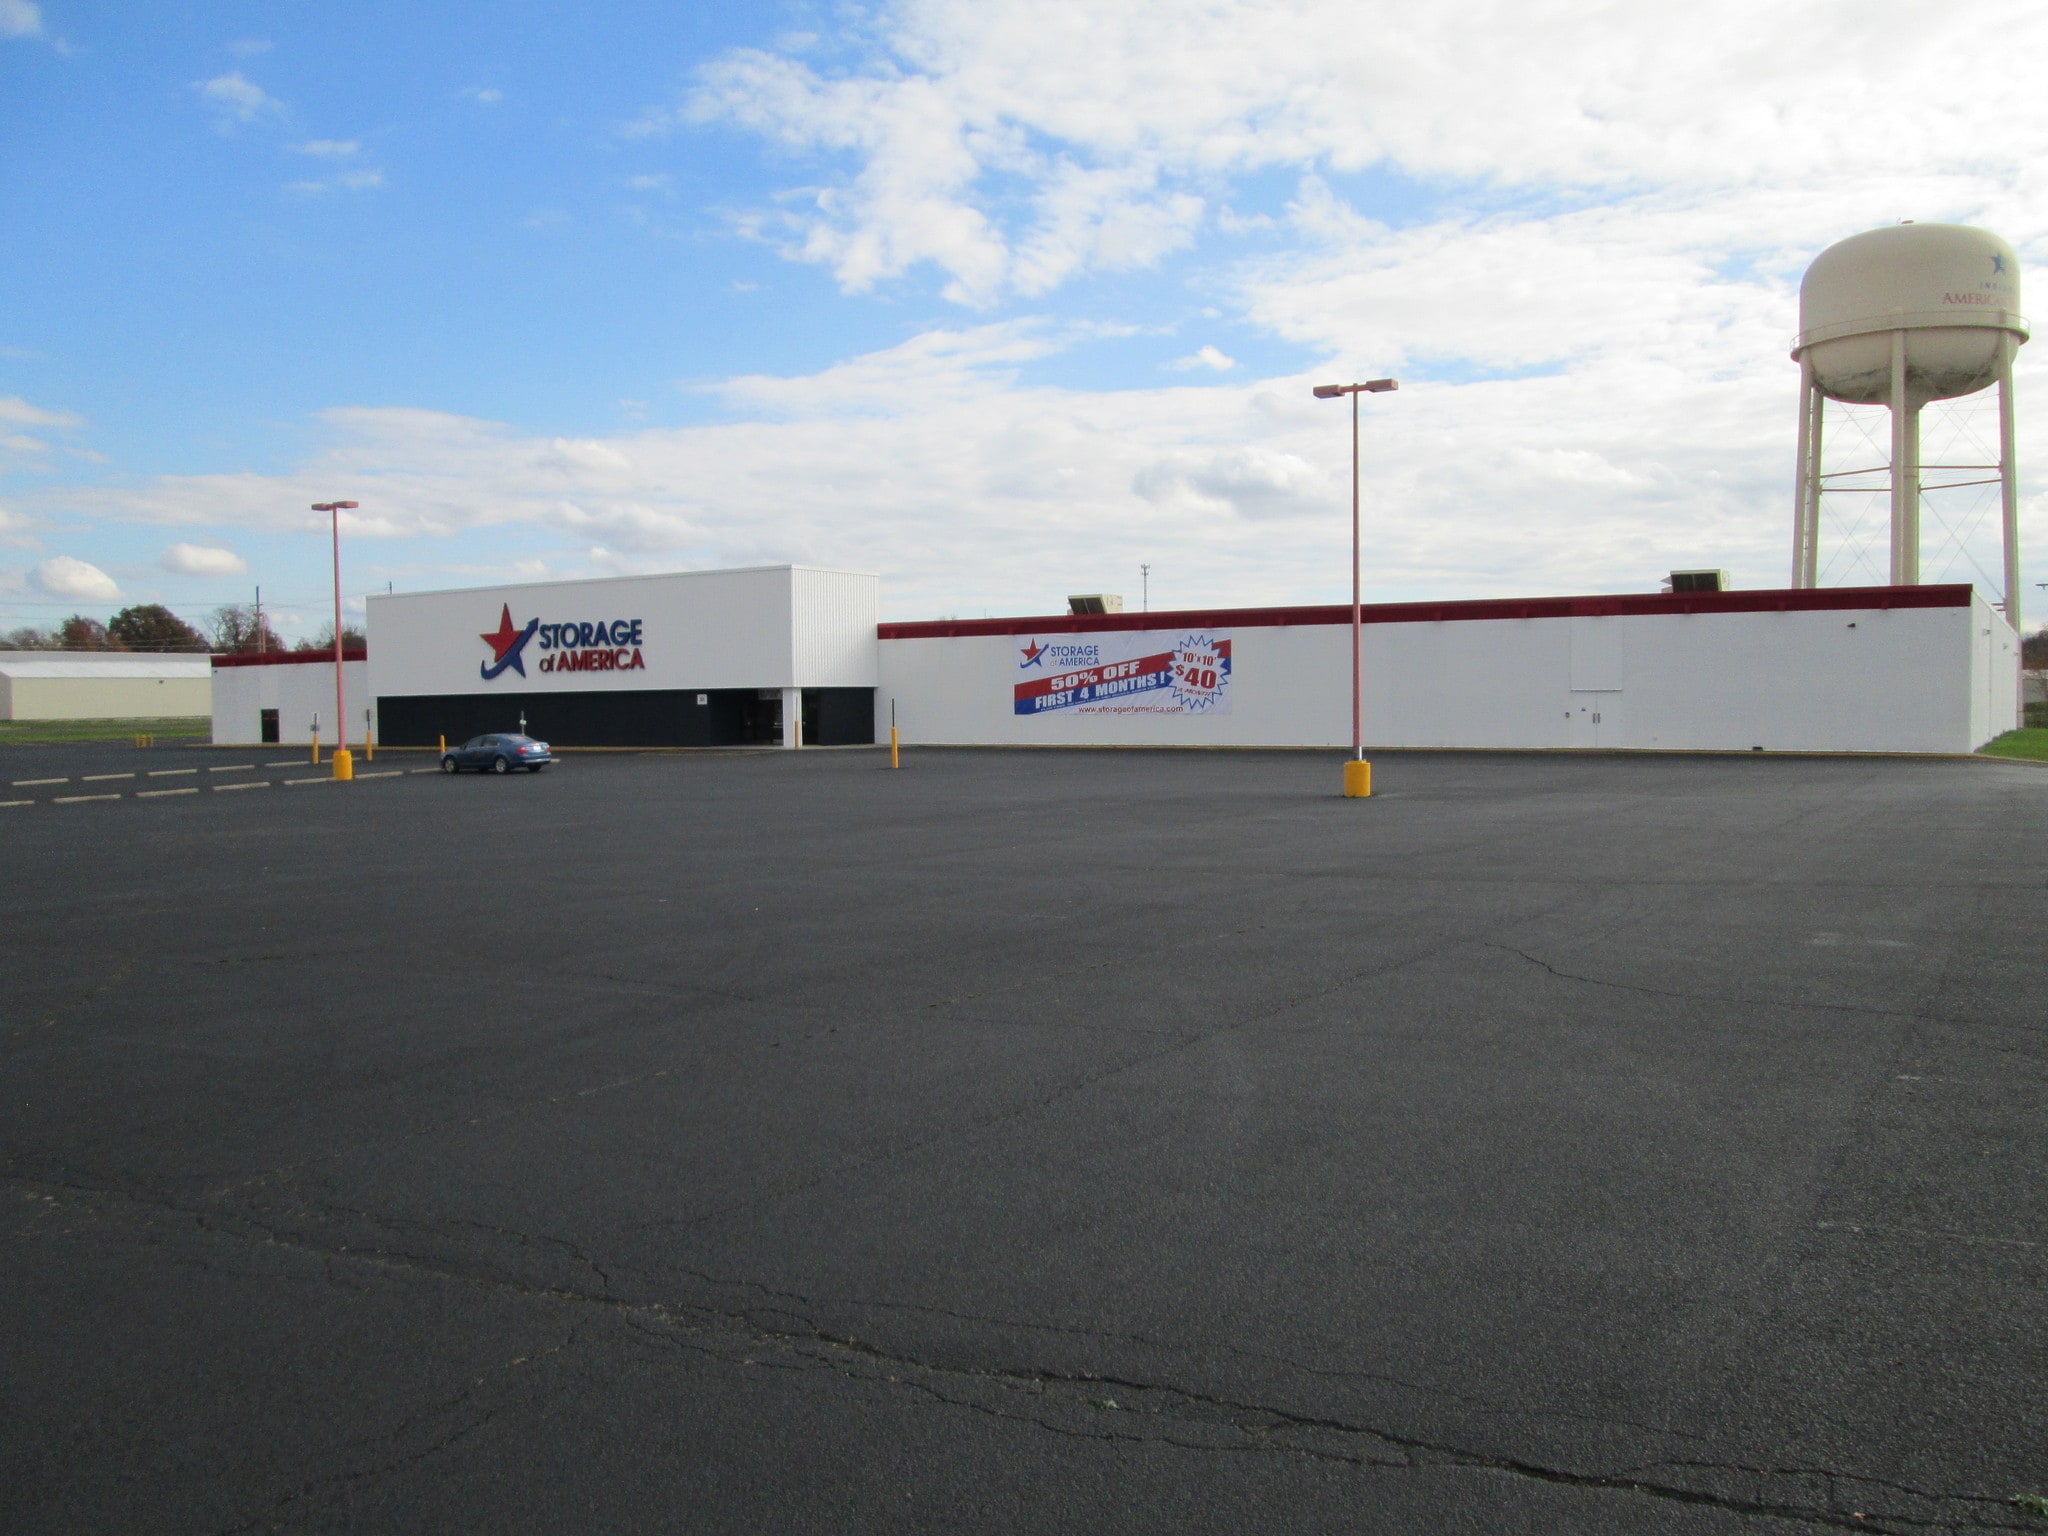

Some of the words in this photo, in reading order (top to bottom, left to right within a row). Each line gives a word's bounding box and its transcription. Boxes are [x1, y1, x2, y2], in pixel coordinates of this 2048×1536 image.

[540, 619, 642, 649] STORAGE
[540, 654, 556, 672] of
[557, 648, 645, 672] AMERICA
[1051, 645, 1099, 656] STORAGE
[1059, 657, 1100, 666] AMERICA
[1051, 669, 1098, 690] 50%
[1103, 660, 1140, 680] OFF
[1175, 664, 1217, 689] $40
[1035, 690, 1074, 709] FIRST
[1080, 686, 1090, 699] 4
[1078, 705, 1184, 714] www.storageofamerica.com
